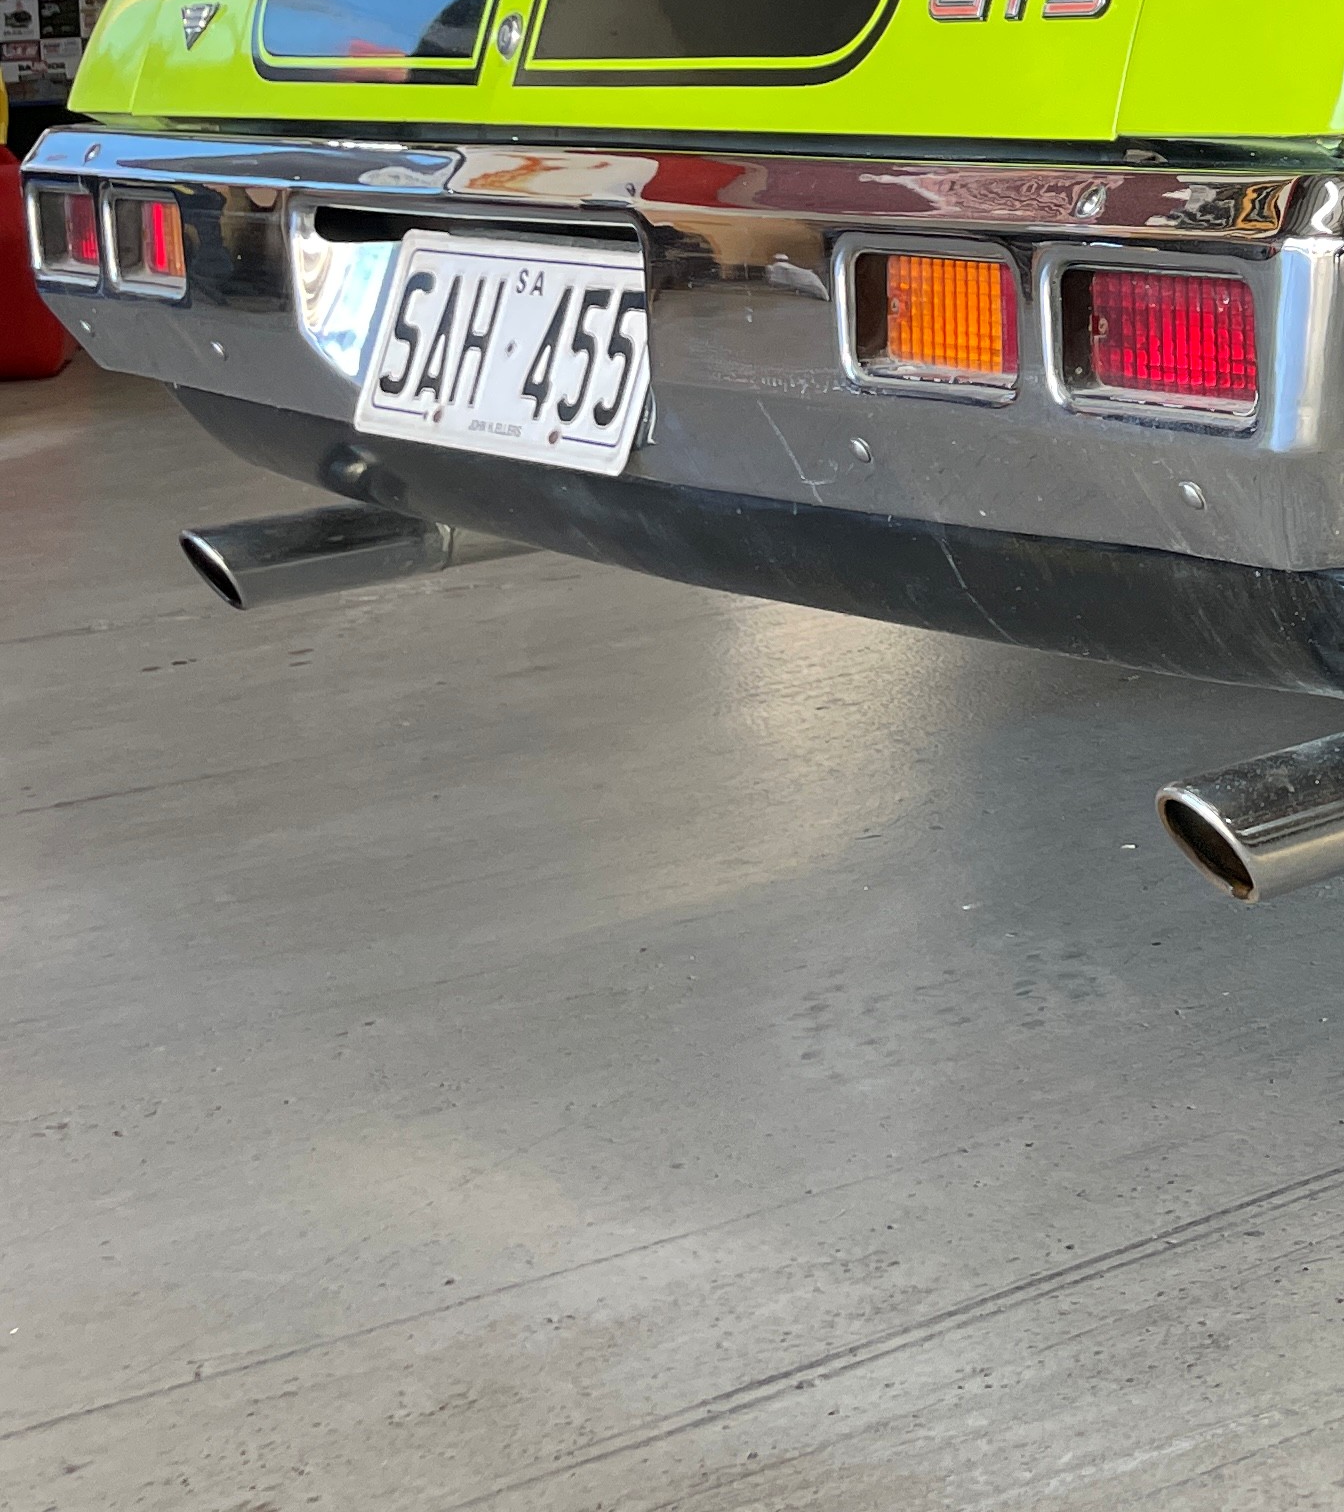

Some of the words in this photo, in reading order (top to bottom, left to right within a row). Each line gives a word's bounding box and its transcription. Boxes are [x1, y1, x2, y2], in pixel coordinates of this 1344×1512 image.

[515, 268, 546, 297] SA
[378, 271, 507, 408] SAH
[520, 285, 647, 427] 455
